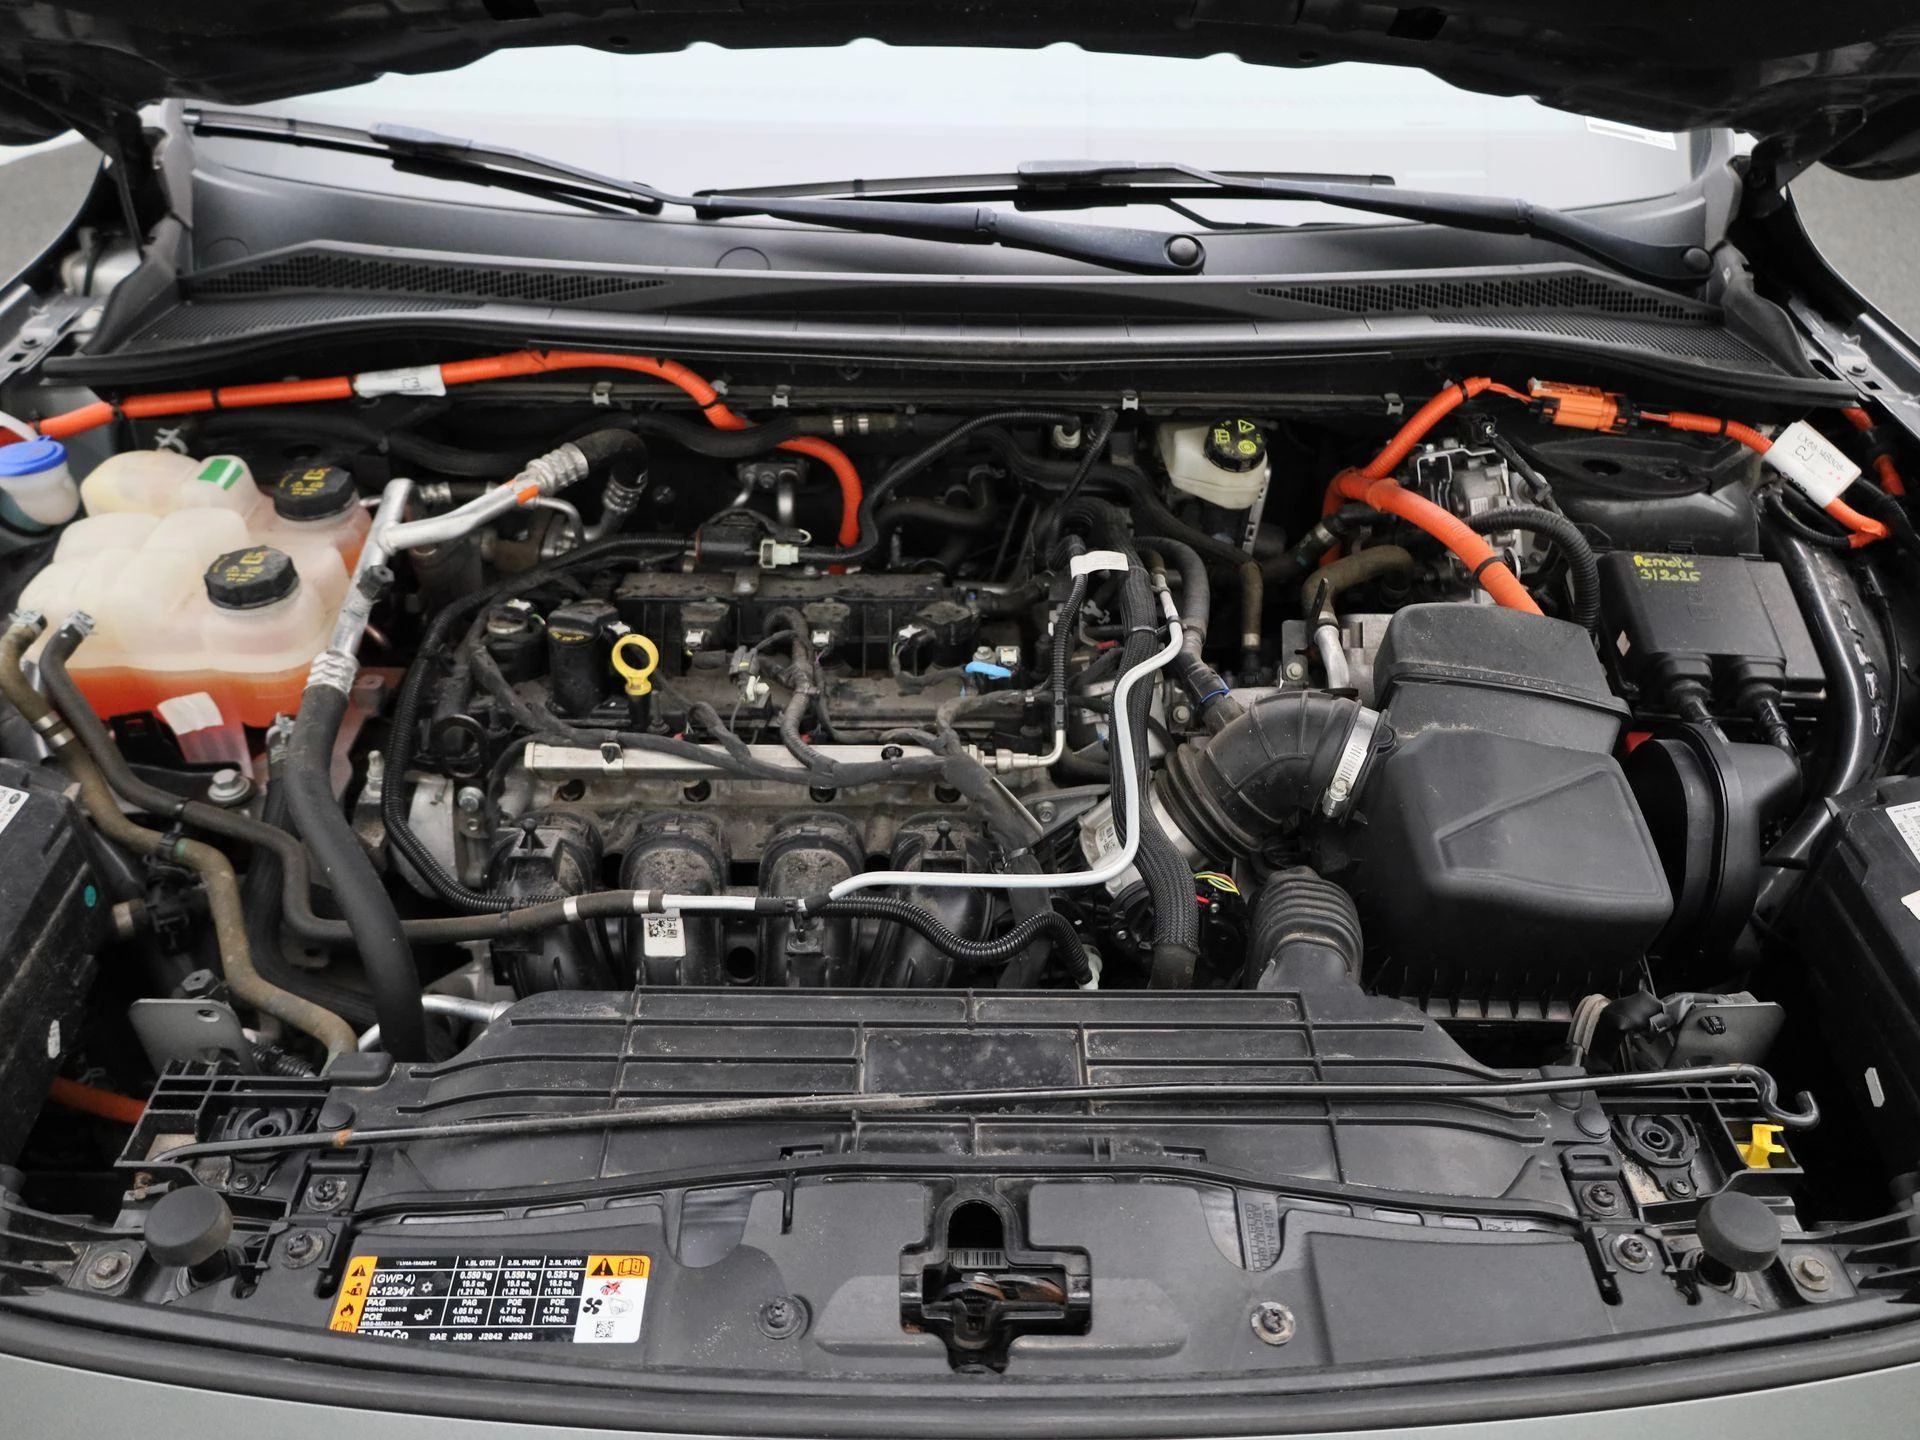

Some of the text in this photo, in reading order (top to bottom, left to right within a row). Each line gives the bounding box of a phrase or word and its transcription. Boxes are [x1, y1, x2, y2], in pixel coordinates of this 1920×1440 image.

[373, 1274, 416, 1284] (GWP 4)
[460, 1271, 492, 1280] 0.550 kg
[504, 1270, 537, 1280] 0.550 kg
[546, 1270, 579, 1280] 0.525 kg
[369, 1286, 415, 1297] R-1234yf
[474, 1288, 488, 1296] lbs)
[519, 1288, 532, 1296] lbs)
[562, 1288, 574, 1296] lbs)
[453, 1332, 472, 1340] J639
